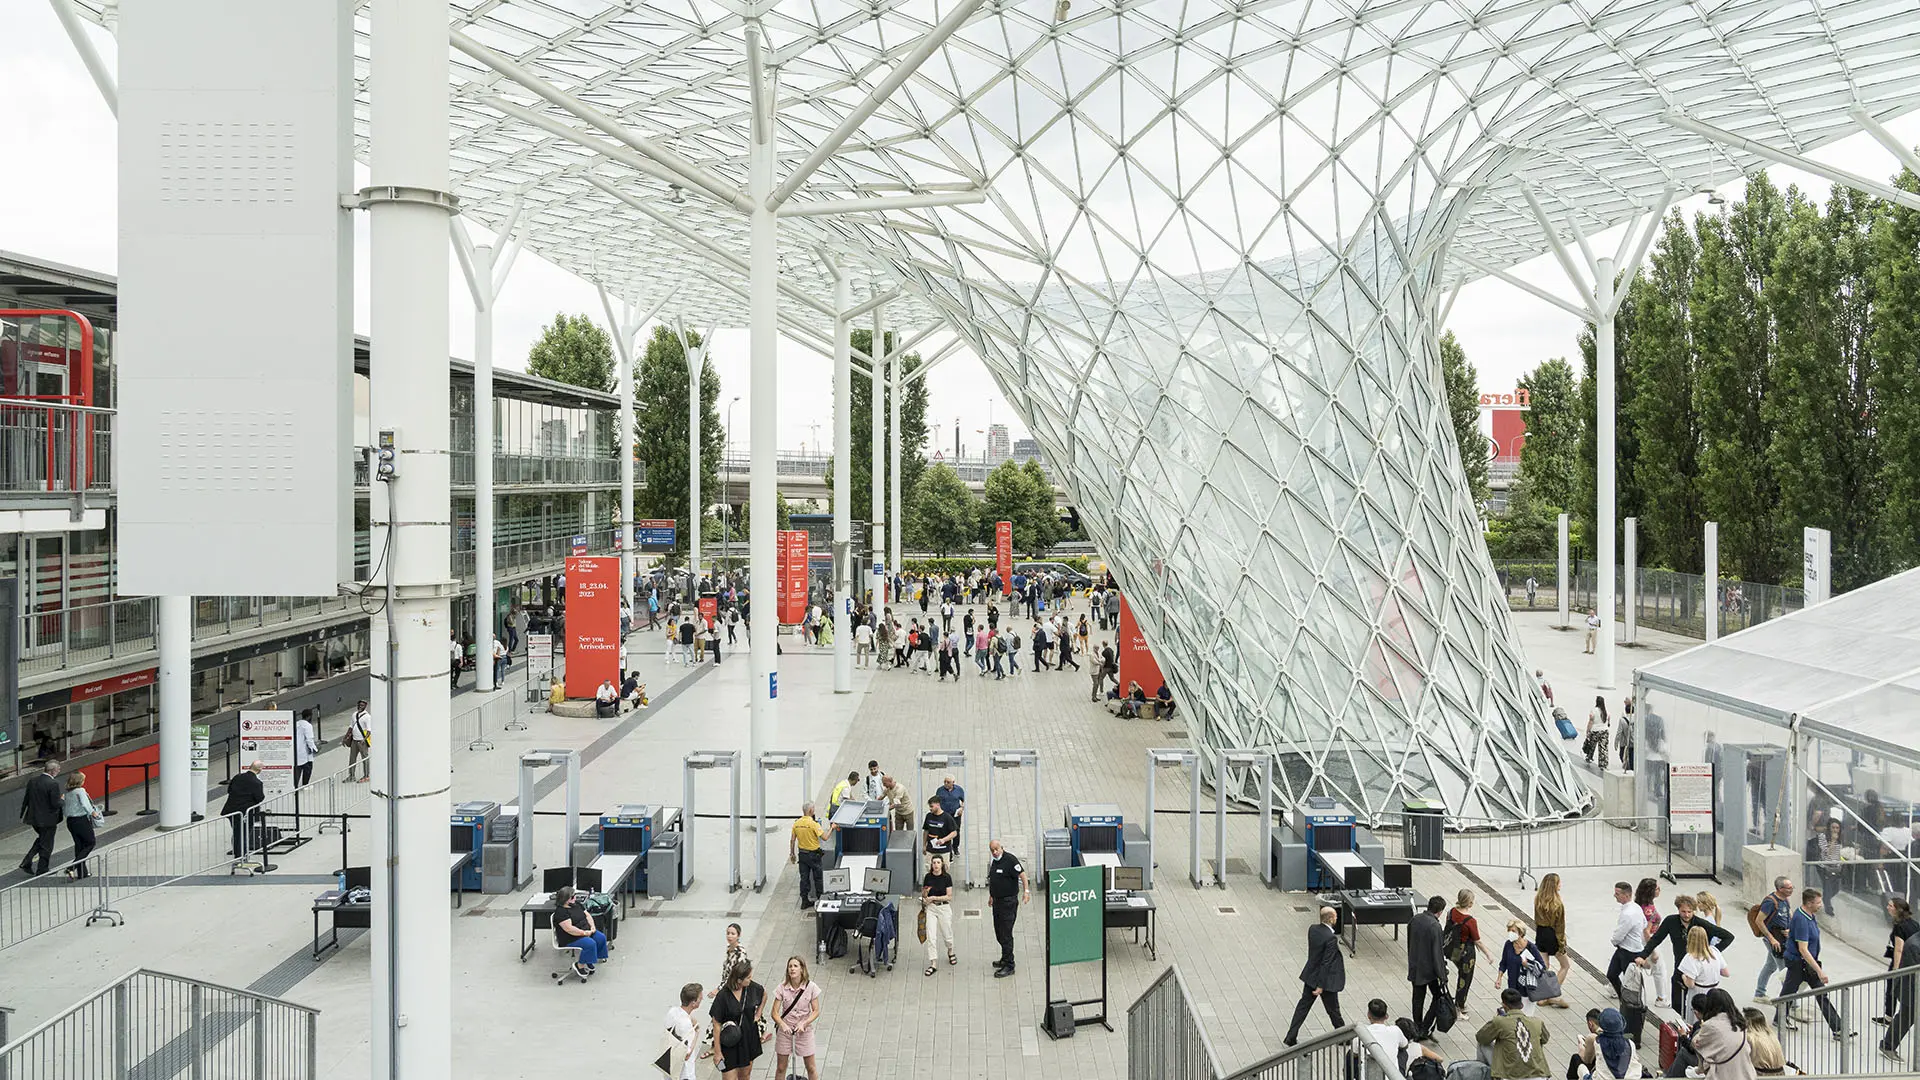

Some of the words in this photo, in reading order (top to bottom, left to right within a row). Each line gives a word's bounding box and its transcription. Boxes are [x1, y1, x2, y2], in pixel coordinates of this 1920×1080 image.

[1132, 636, 1145, 644] See
[1052, 889, 1097, 904] USCITA
[1052, 906, 1080, 919] EXIT
